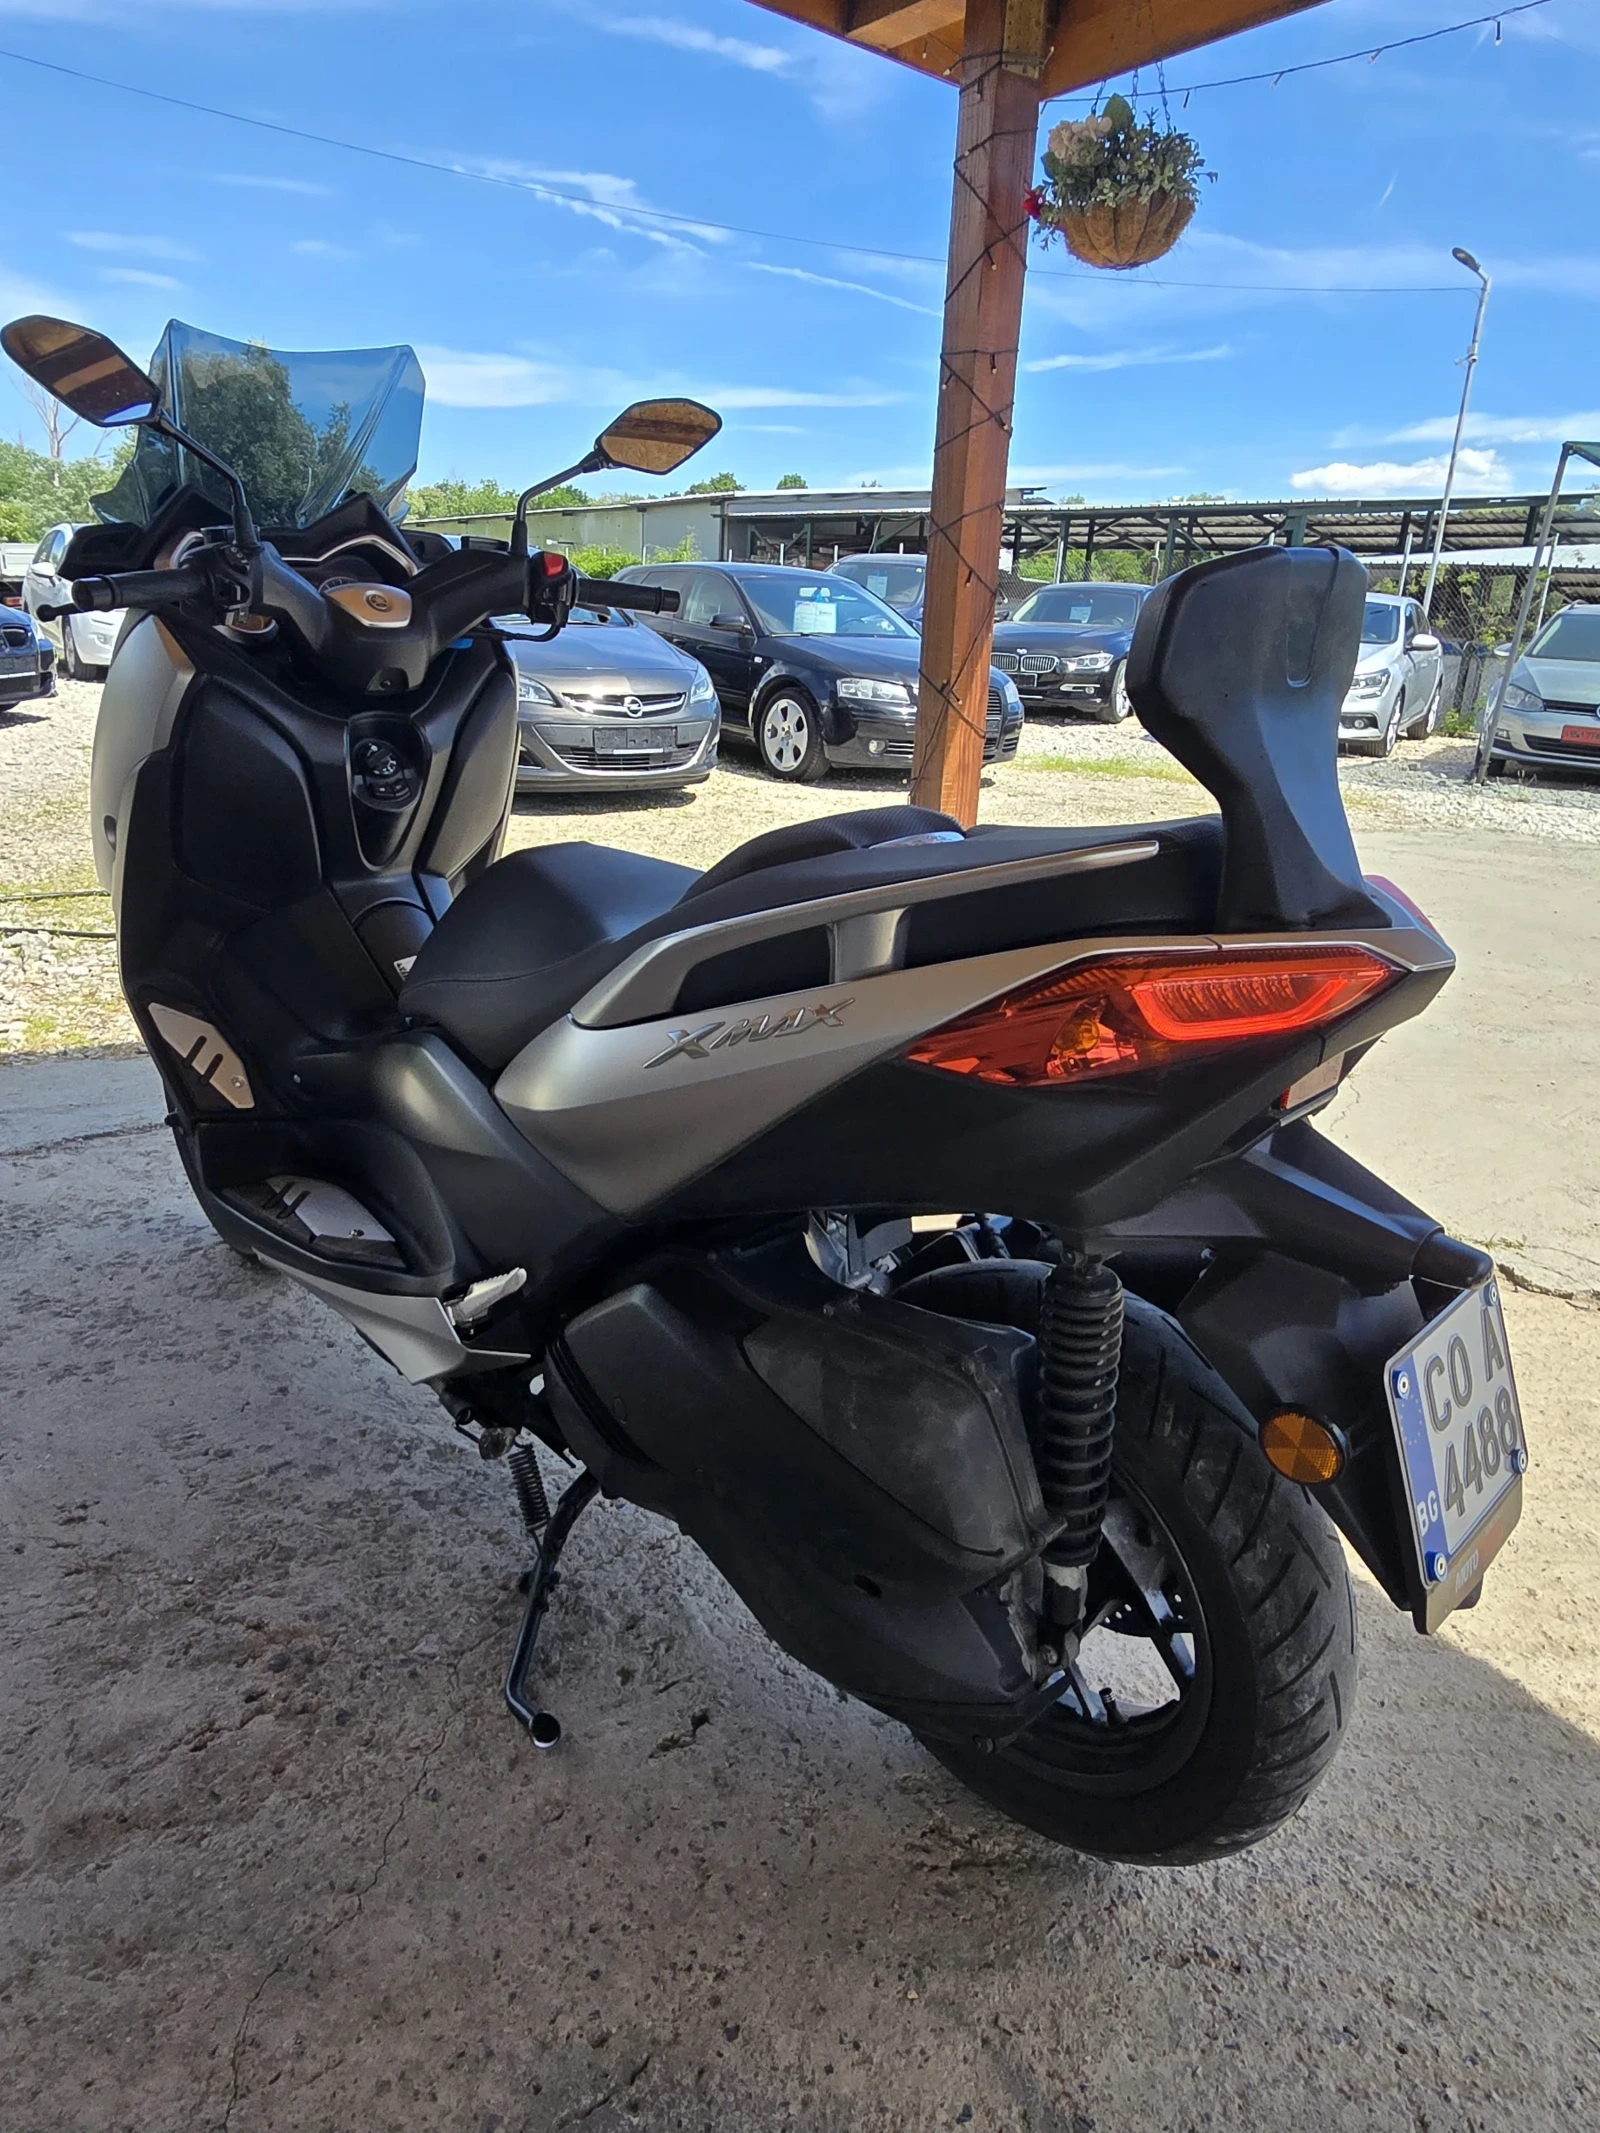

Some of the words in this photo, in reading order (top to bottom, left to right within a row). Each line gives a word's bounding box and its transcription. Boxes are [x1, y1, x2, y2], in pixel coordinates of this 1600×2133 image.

[1424, 1333, 1472, 1433] CO
[1480, 1305, 1505, 1382] A
[1417, 1490, 1438, 1537] BG
[1444, 1386, 1518, 1518] 4488
